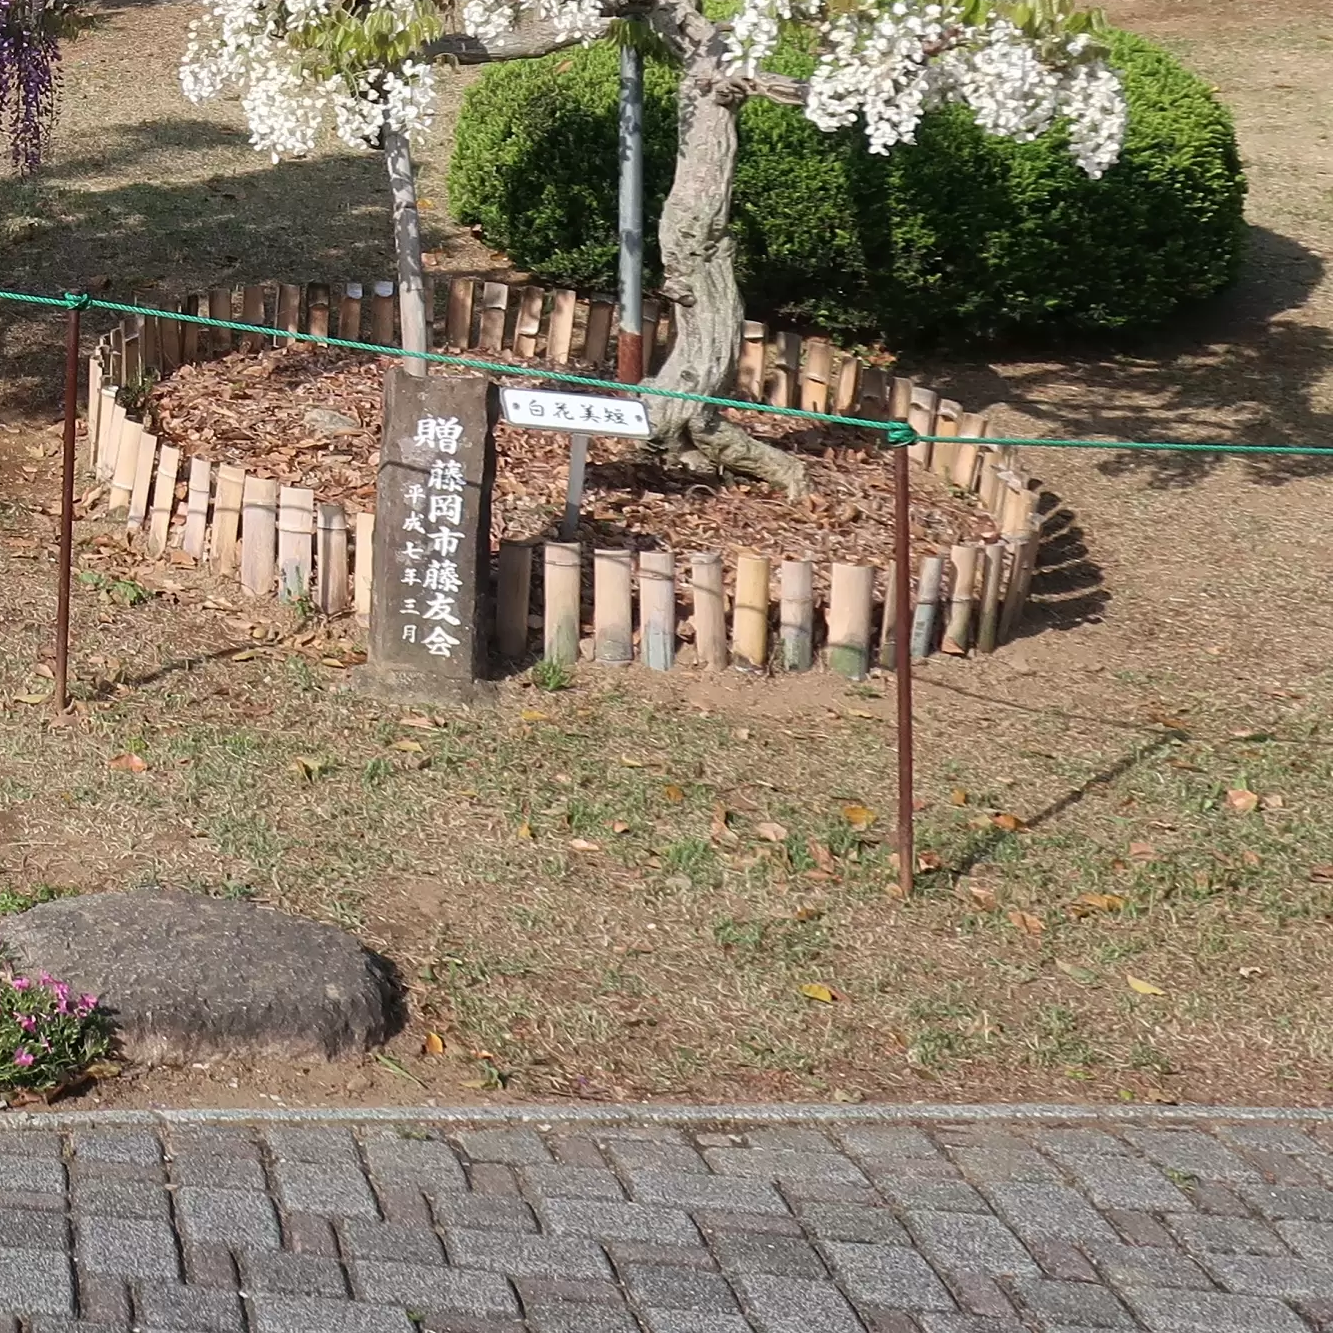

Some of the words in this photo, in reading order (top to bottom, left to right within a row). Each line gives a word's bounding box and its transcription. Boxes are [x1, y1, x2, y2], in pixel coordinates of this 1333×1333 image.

[529, 399, 629, 426] 白花美短
[400, 485, 426, 644] 平成七年三月
